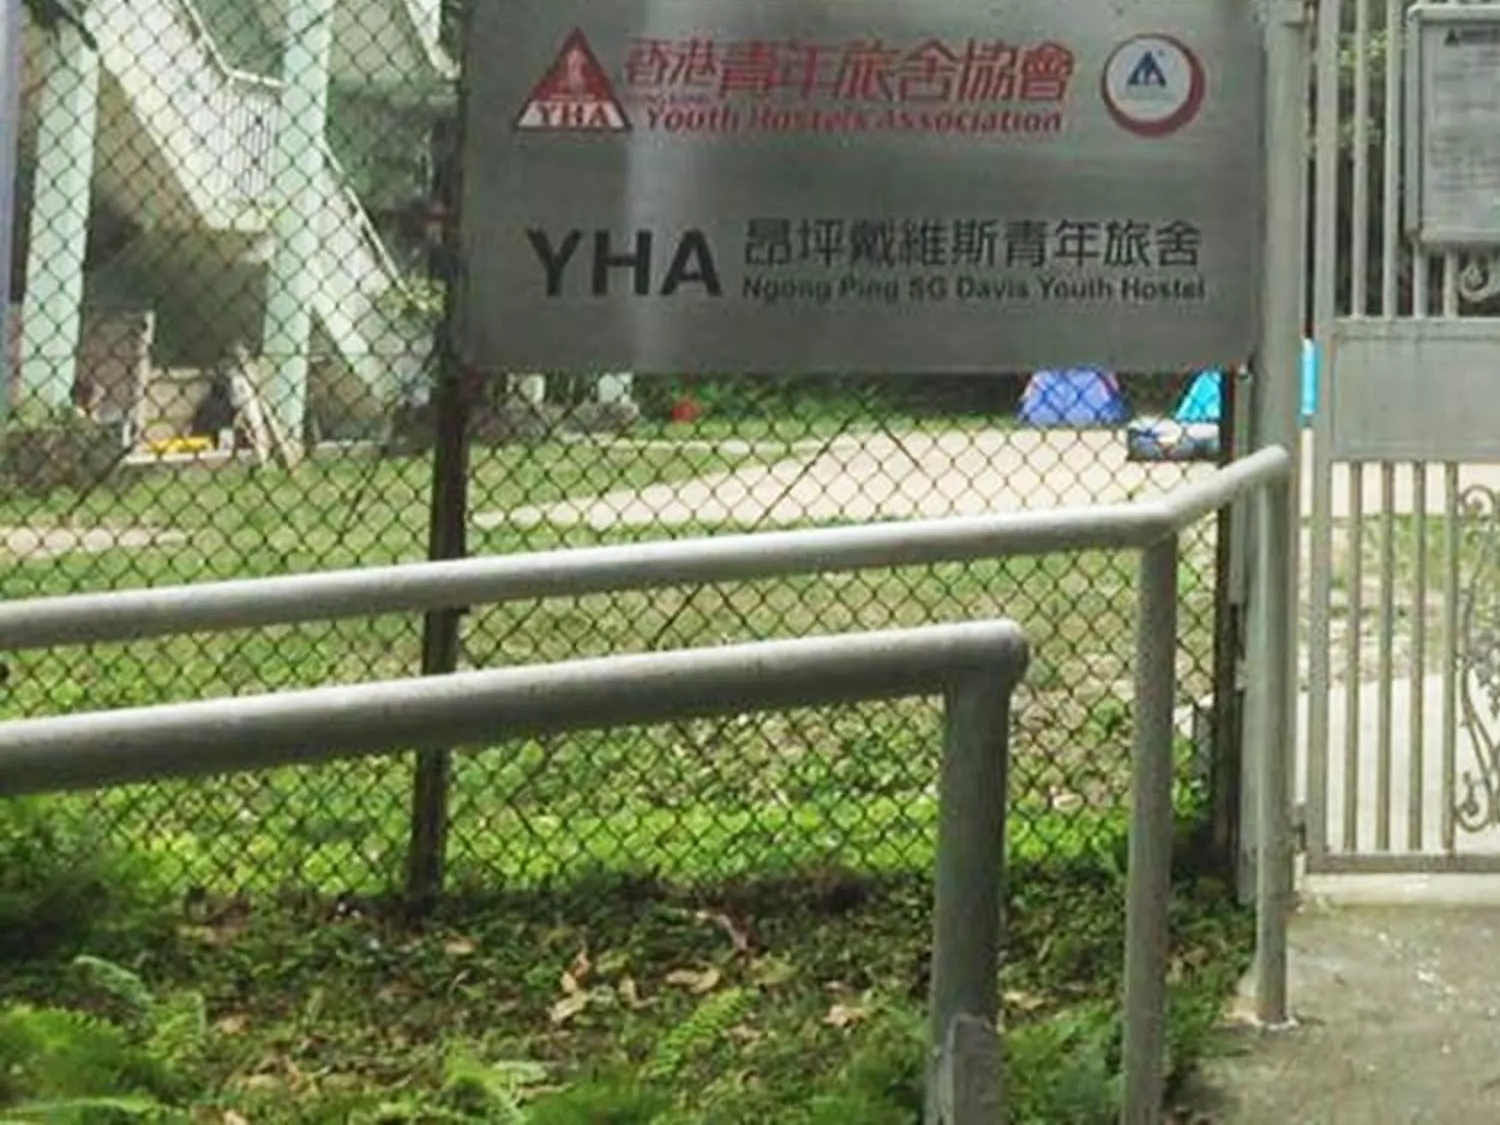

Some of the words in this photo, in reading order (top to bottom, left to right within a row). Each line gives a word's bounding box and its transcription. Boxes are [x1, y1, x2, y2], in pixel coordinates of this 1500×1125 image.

[624, 35, 1075, 101] 香港青年旅舍協會
[539, 101, 612, 126] YHA
[647, 106, 739, 133] Youth
[877, 108, 1063, 133] Association
[526, 228, 722, 297] YHA
[742, 277, 832, 305] Ngong
[838, 277, 899, 305] Ping
[956, 277, 1029, 300] Davis
[1038, 277, 1112, 300] Youth
[1121, 277, 1206, 301] Hostel
